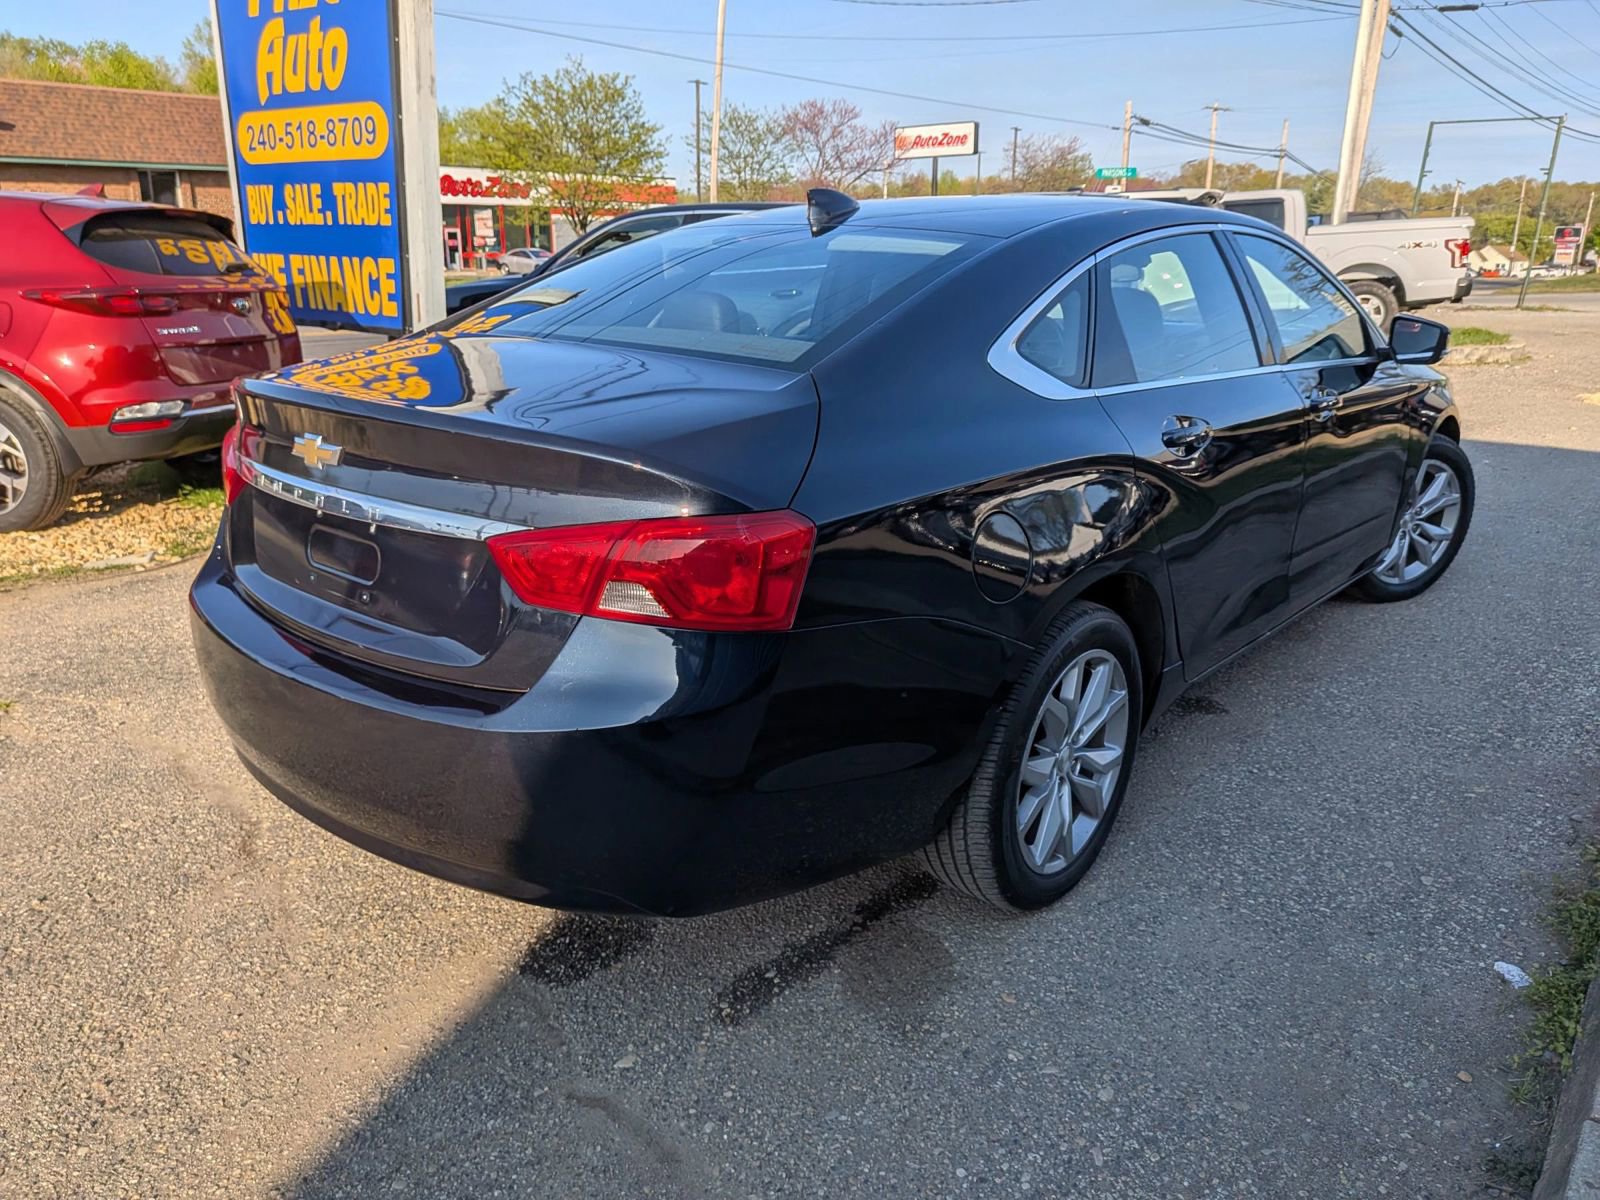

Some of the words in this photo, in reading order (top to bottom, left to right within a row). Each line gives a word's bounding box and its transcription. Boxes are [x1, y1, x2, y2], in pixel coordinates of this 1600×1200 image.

[256, 15, 348, 106] Auto
[246, 115, 377, 153] 240-518-8709
[910, 131, 969, 149] AutoZone
[332, 182, 392, 227] TRADE
[289, 253, 399, 318] FINANCE
